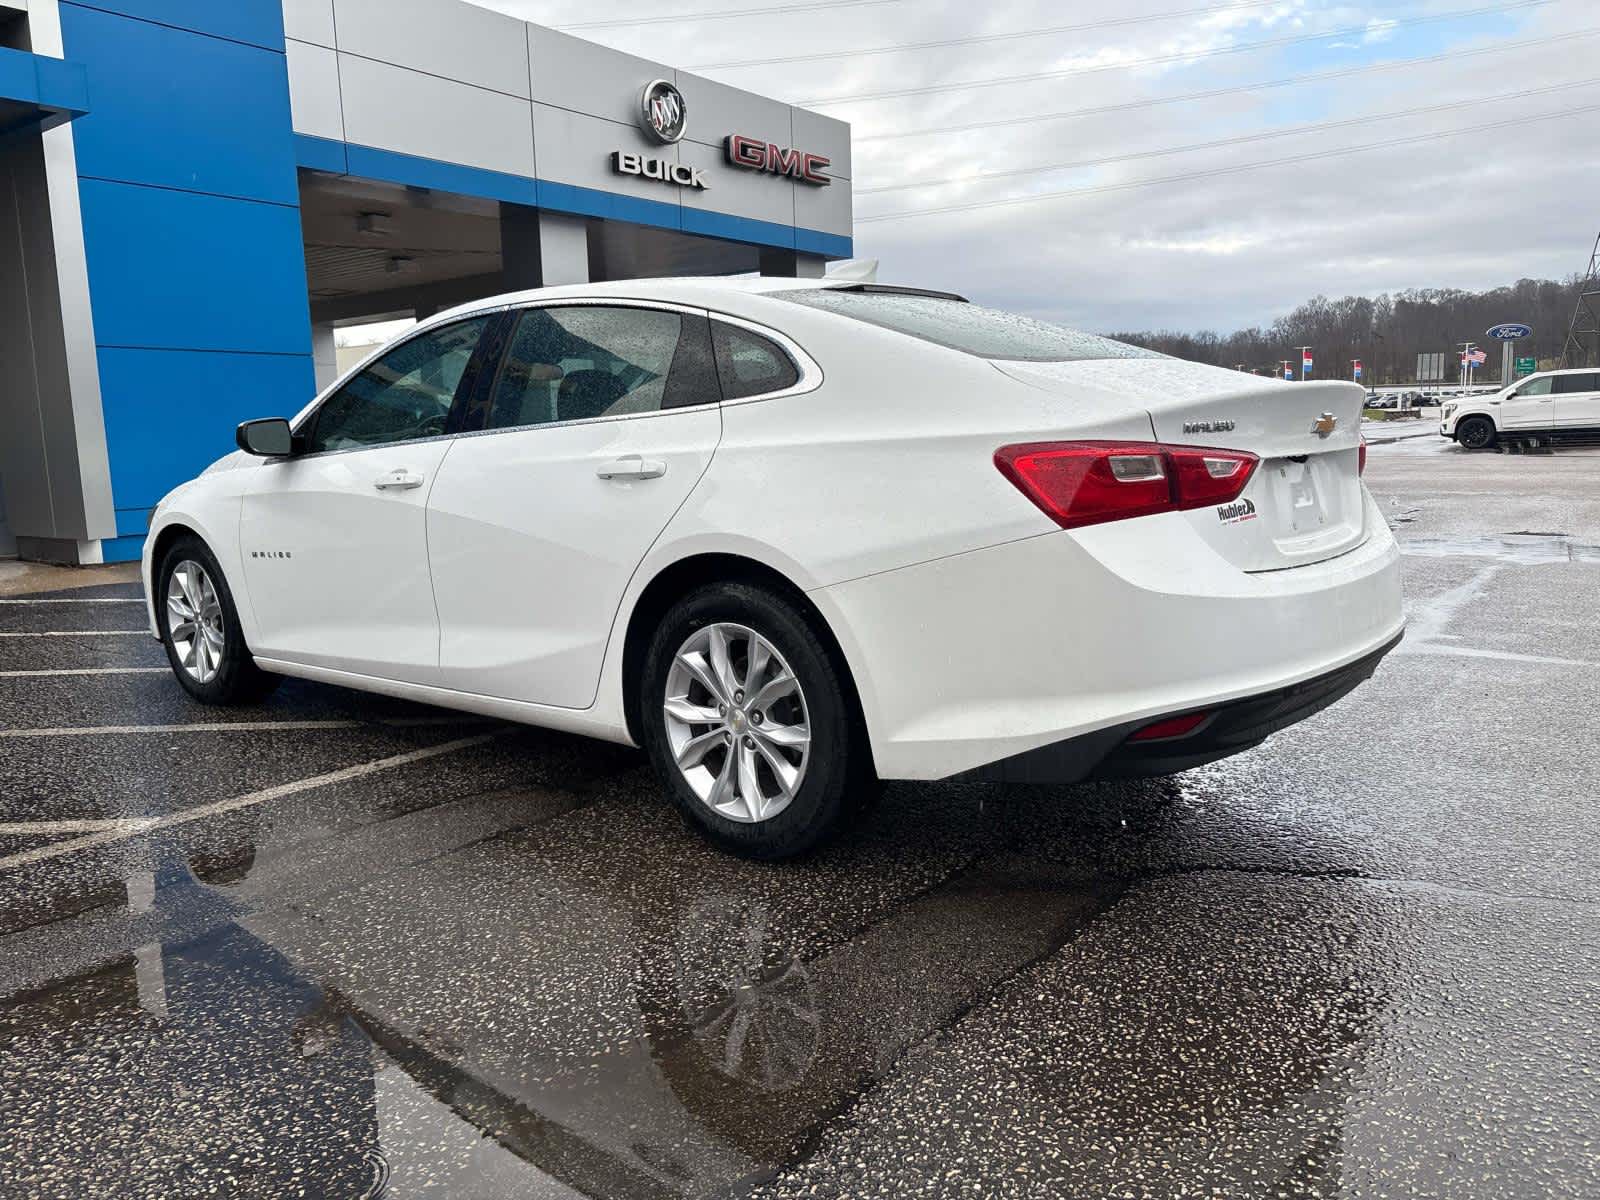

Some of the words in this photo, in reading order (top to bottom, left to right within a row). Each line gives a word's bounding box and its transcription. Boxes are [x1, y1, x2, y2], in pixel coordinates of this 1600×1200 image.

[726, 134, 831, 186] GMC
[614, 150, 709, 190] BUICK
[1496, 327, 1524, 338] Ford
[1183, 420, 1235, 433] MALIBU
[1217, 503, 1247, 521] Hubler
[251, 551, 292, 559] MALIBU
